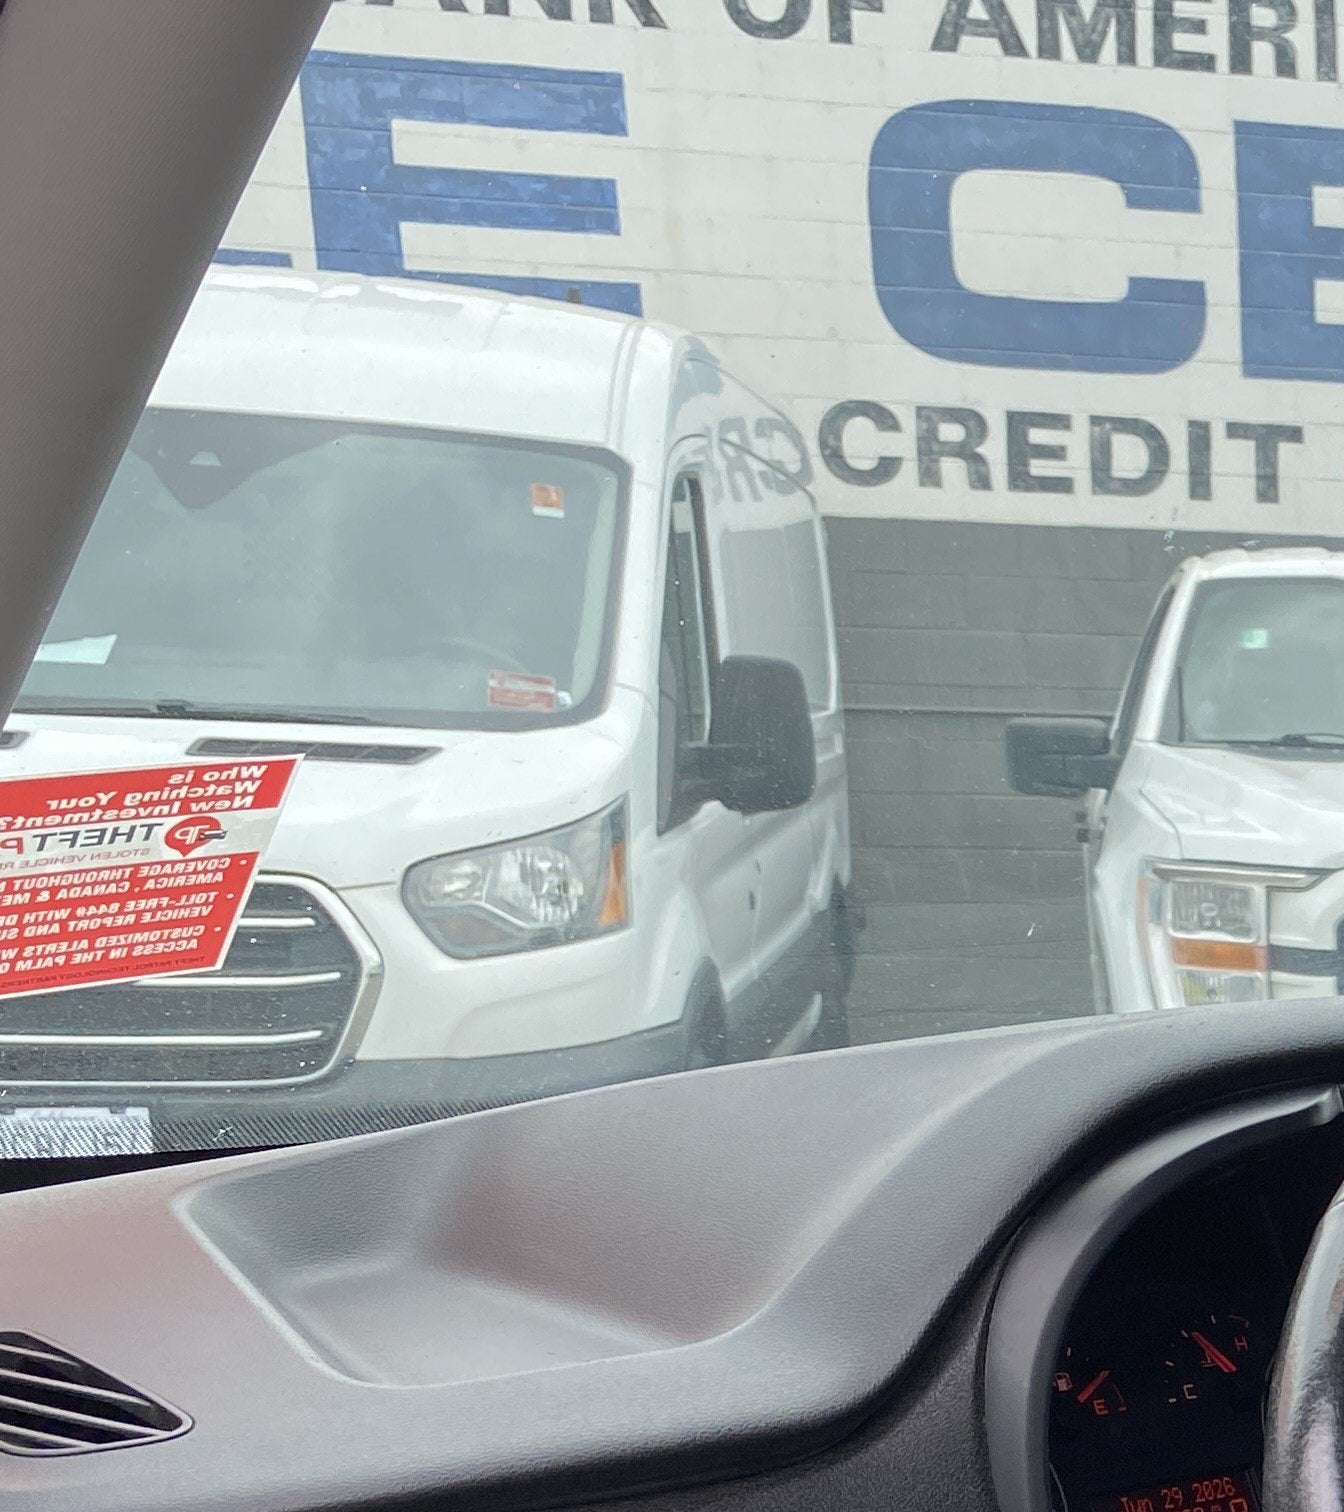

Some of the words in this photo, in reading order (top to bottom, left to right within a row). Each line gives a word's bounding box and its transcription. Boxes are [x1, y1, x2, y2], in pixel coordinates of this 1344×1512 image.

[817, 400, 1305, 504] CREDIT
[1183, 1384, 1198, 1400] C
[1093, 1399, 1110, 1416] E
[1161, 1486, 1184, 1509] 29
[1192, 1477, 1236, 1503] 2026
